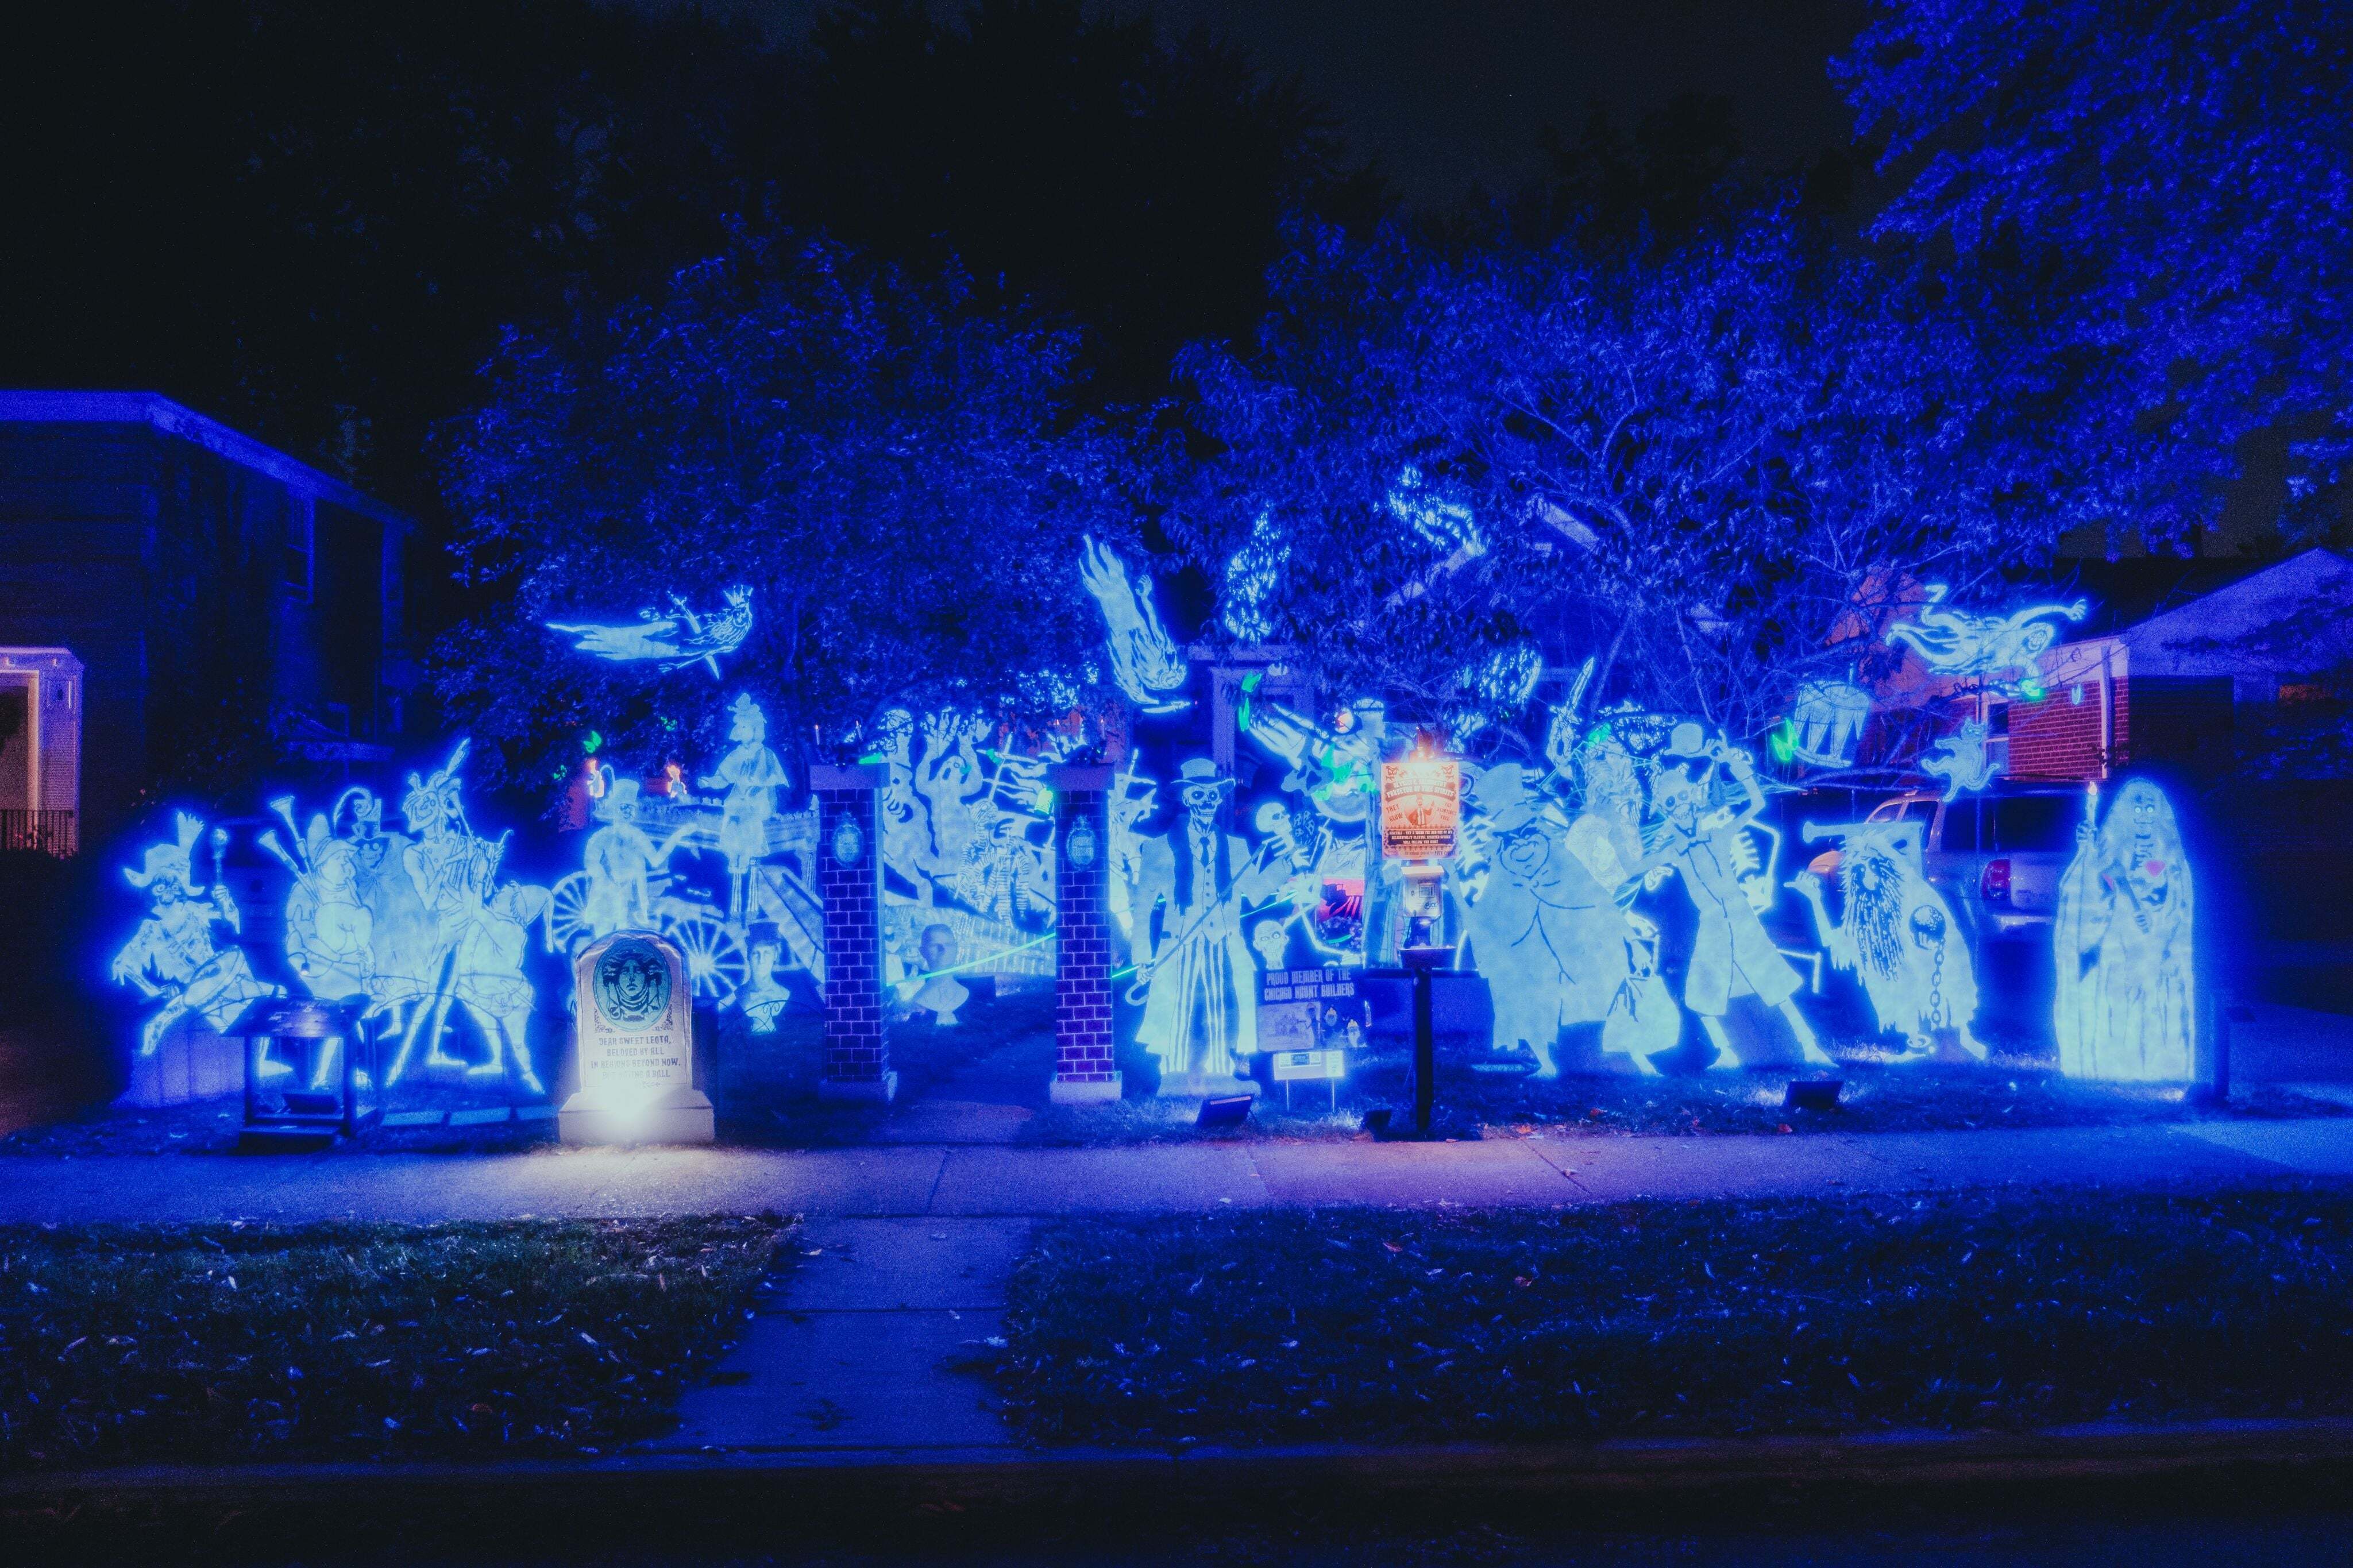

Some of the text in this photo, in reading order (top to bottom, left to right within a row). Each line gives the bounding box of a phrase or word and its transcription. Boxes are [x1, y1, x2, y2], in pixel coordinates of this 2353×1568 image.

[1386, 804, 1399, 813] THEY
[1388, 813, 1403, 821] GLOW
[1267, 968, 1351, 986] PROUD MEMBER OF THE
[1264, 983, 1355, 1001] CHICAGO HAUNT BUILDERS
[599, 1037, 617, 1046] DEAR
[607, 1046, 664, 1056] BELOVED BY ALL
[591, 1061, 598, 1069] IN
[632, 1059, 659, 1067] BEYOND
[653, 1069, 671, 1078] BALL
